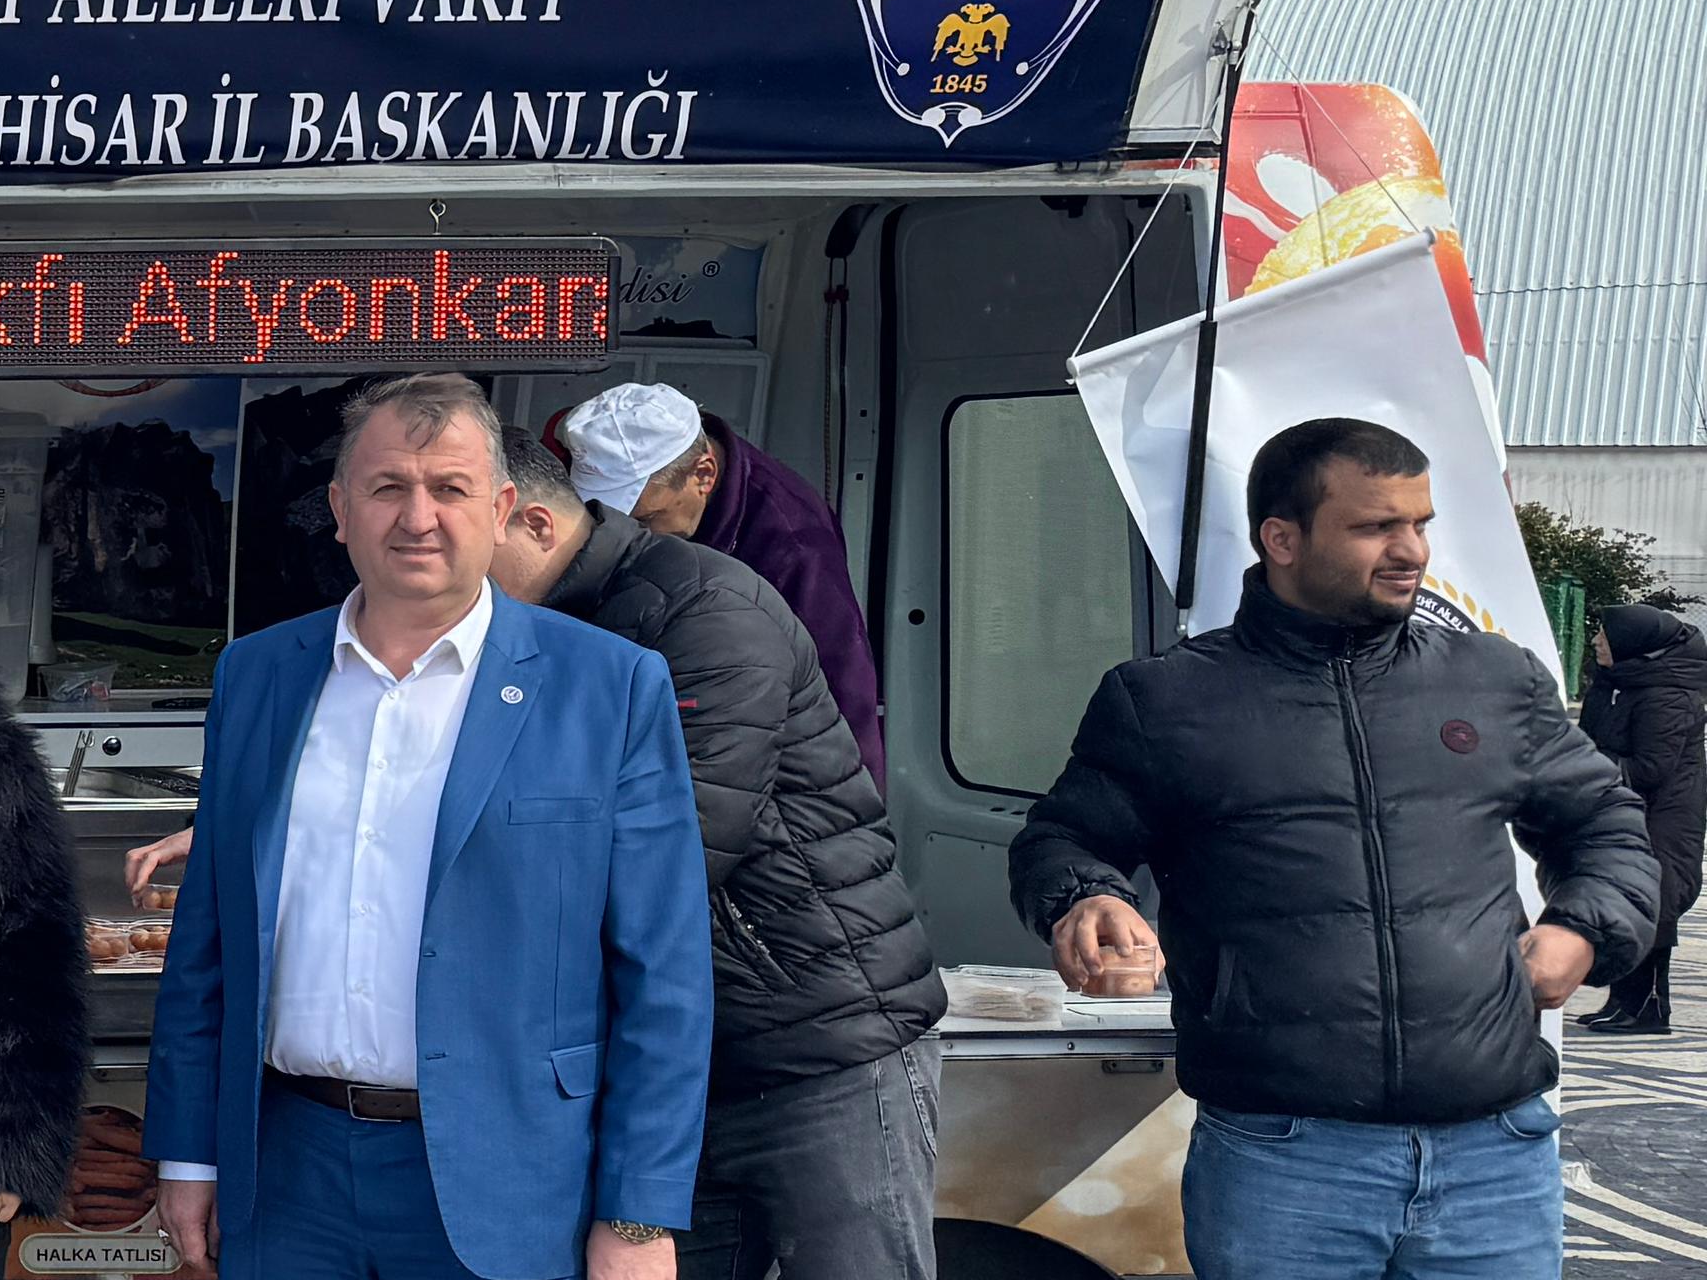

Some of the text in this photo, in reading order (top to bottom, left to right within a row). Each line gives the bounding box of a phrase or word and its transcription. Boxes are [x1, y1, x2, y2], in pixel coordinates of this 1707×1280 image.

[929, 73, 989, 95] 1845
[202, 72, 267, 165] İL
[116, 249, 608, 364] Afyonkar
[36, 1248, 167, 1262] HALKA TATLISI
